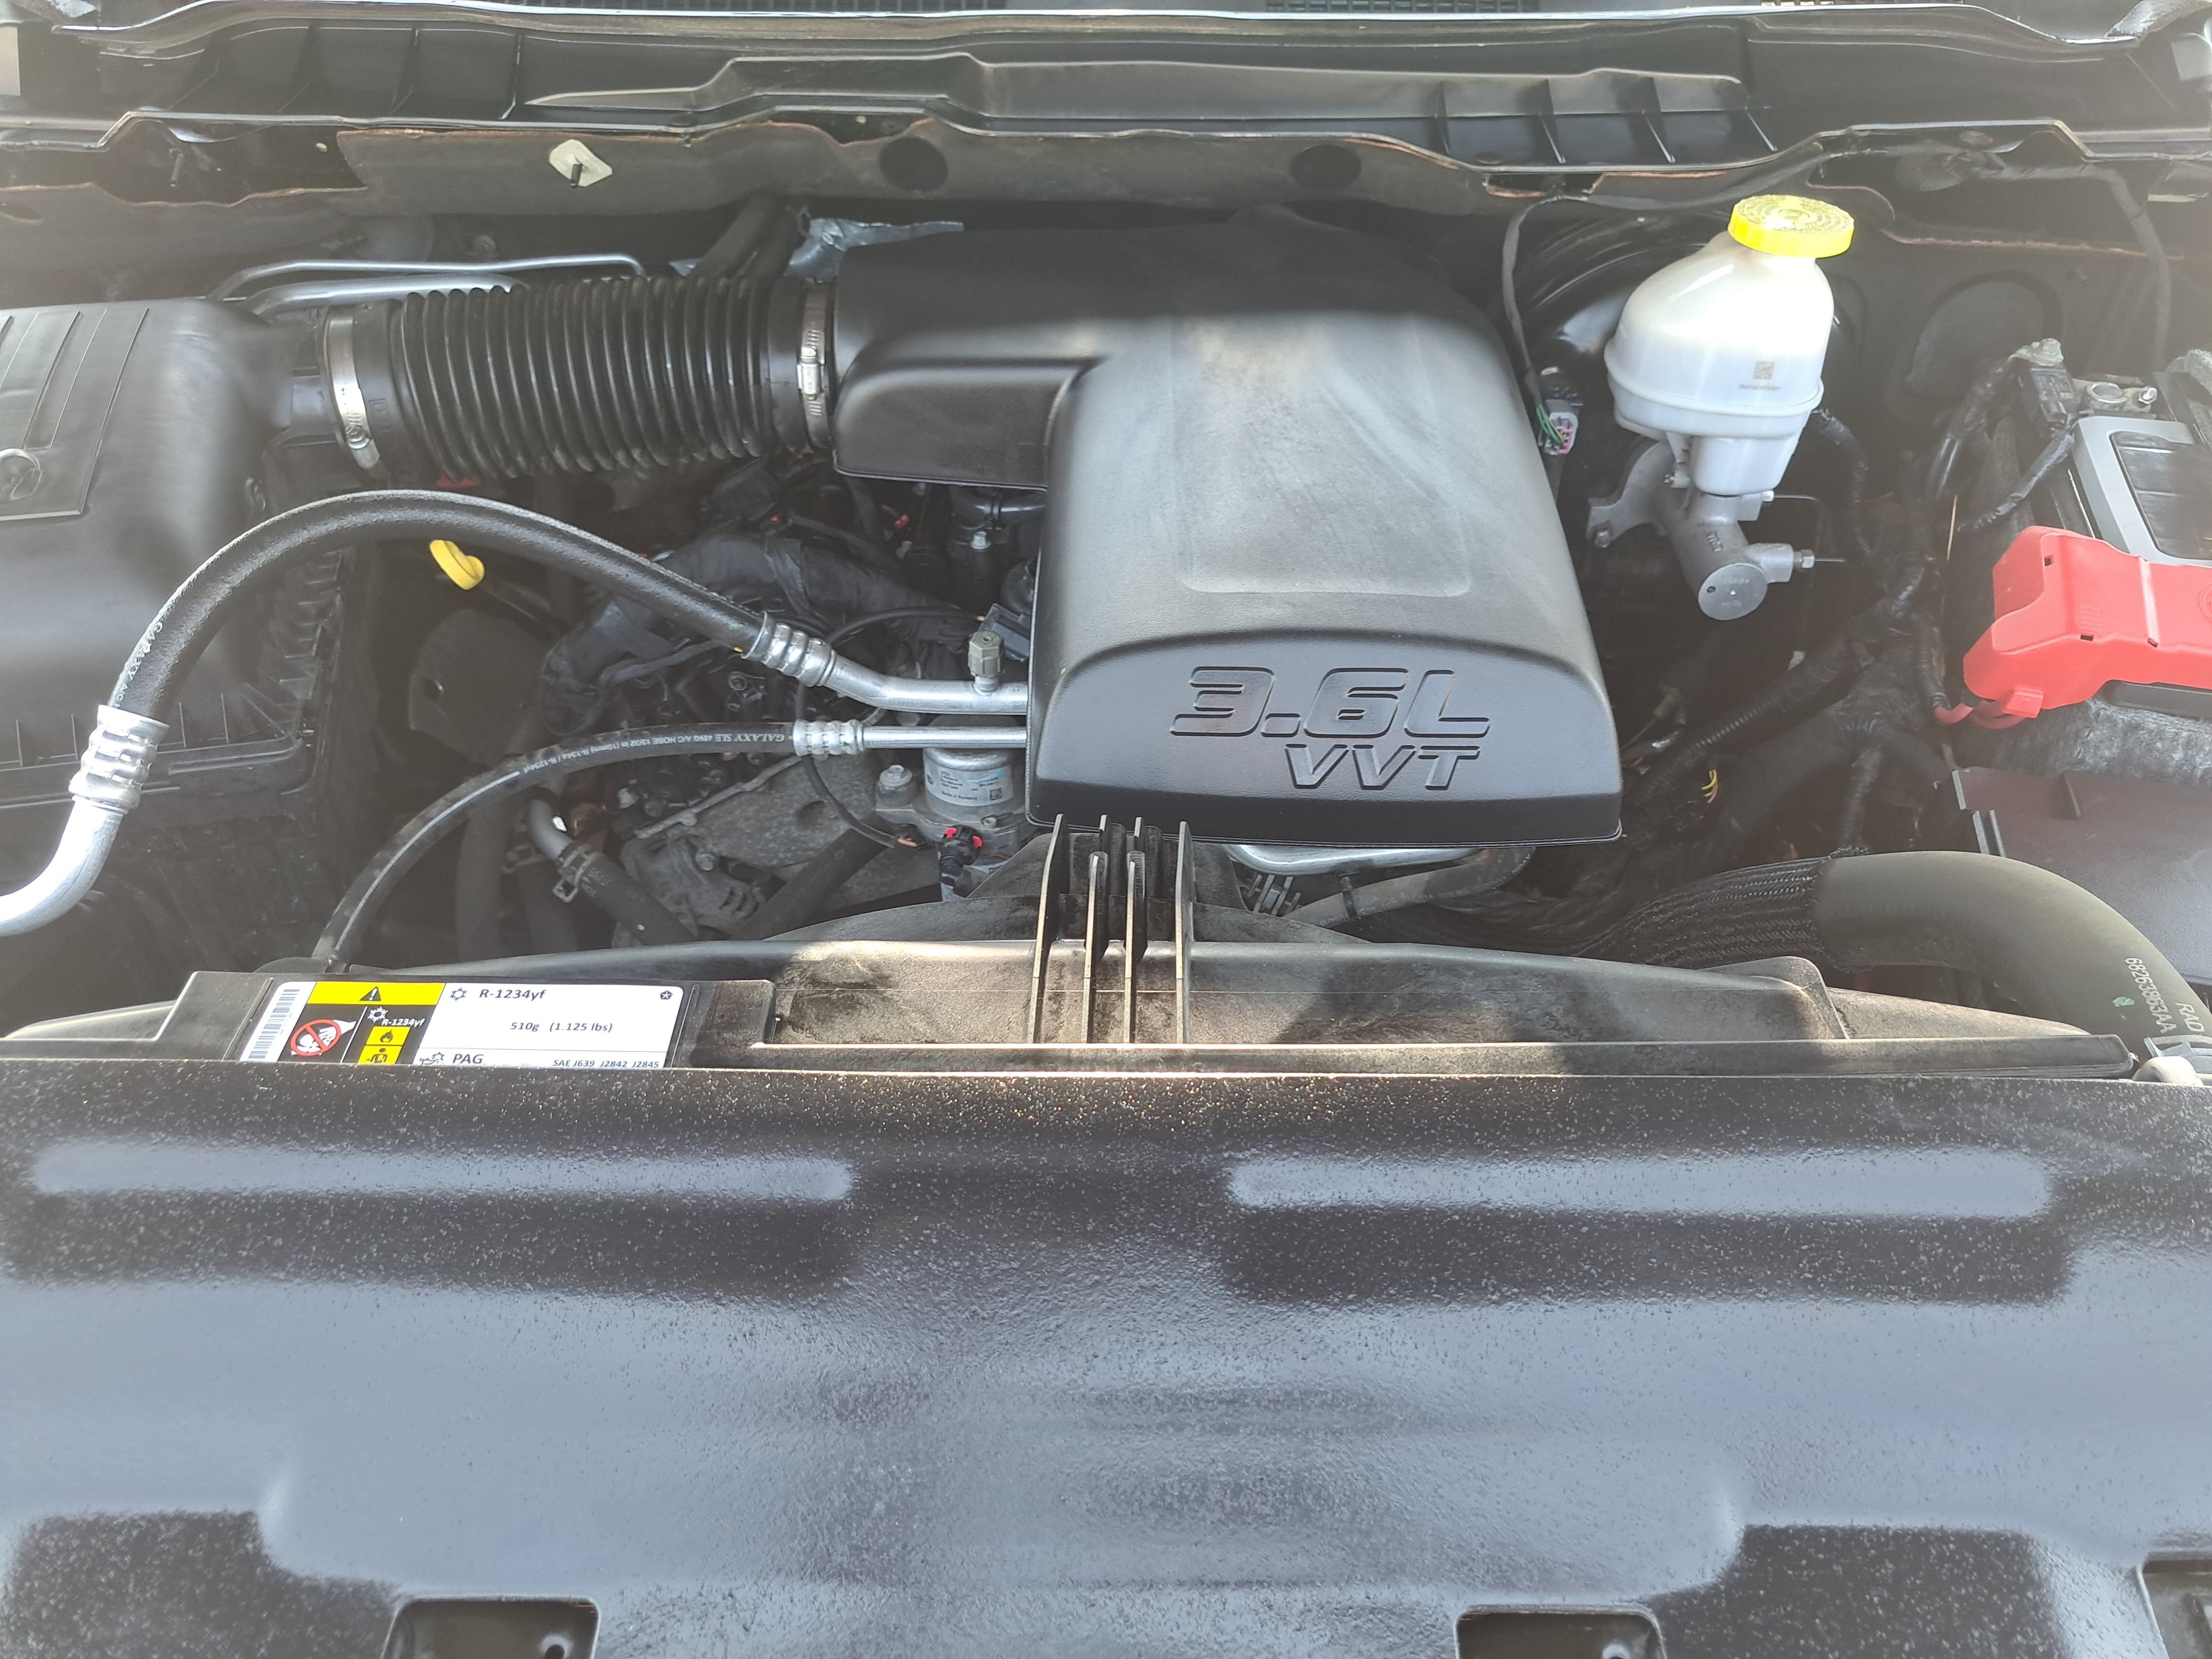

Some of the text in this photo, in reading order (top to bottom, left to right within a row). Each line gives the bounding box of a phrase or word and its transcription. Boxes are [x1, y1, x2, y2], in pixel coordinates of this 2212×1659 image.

[128, 621, 163, 681] GAAXY
[1170, 666, 1491, 738] 3.6L
[630, 738, 651, 747] 13/32
[653, 736, 676, 745] HOSE
[677, 735, 692, 743] A/C
[716, 734, 732, 742] SLE
[735, 733, 785, 742] GALAXY
[591, 741, 620, 754] (10mm)
[1284, 743, 1480, 790] VVT
[479, 989, 546, 1001] R-1234yf
[2175, 1002, 2205, 1033] RAD
[381, 1018, 425, 1028] R-1234yf
[510, 1022, 612, 1033] 510g (1.125 lbs)
[453, 1054, 484, 1064] PAG
